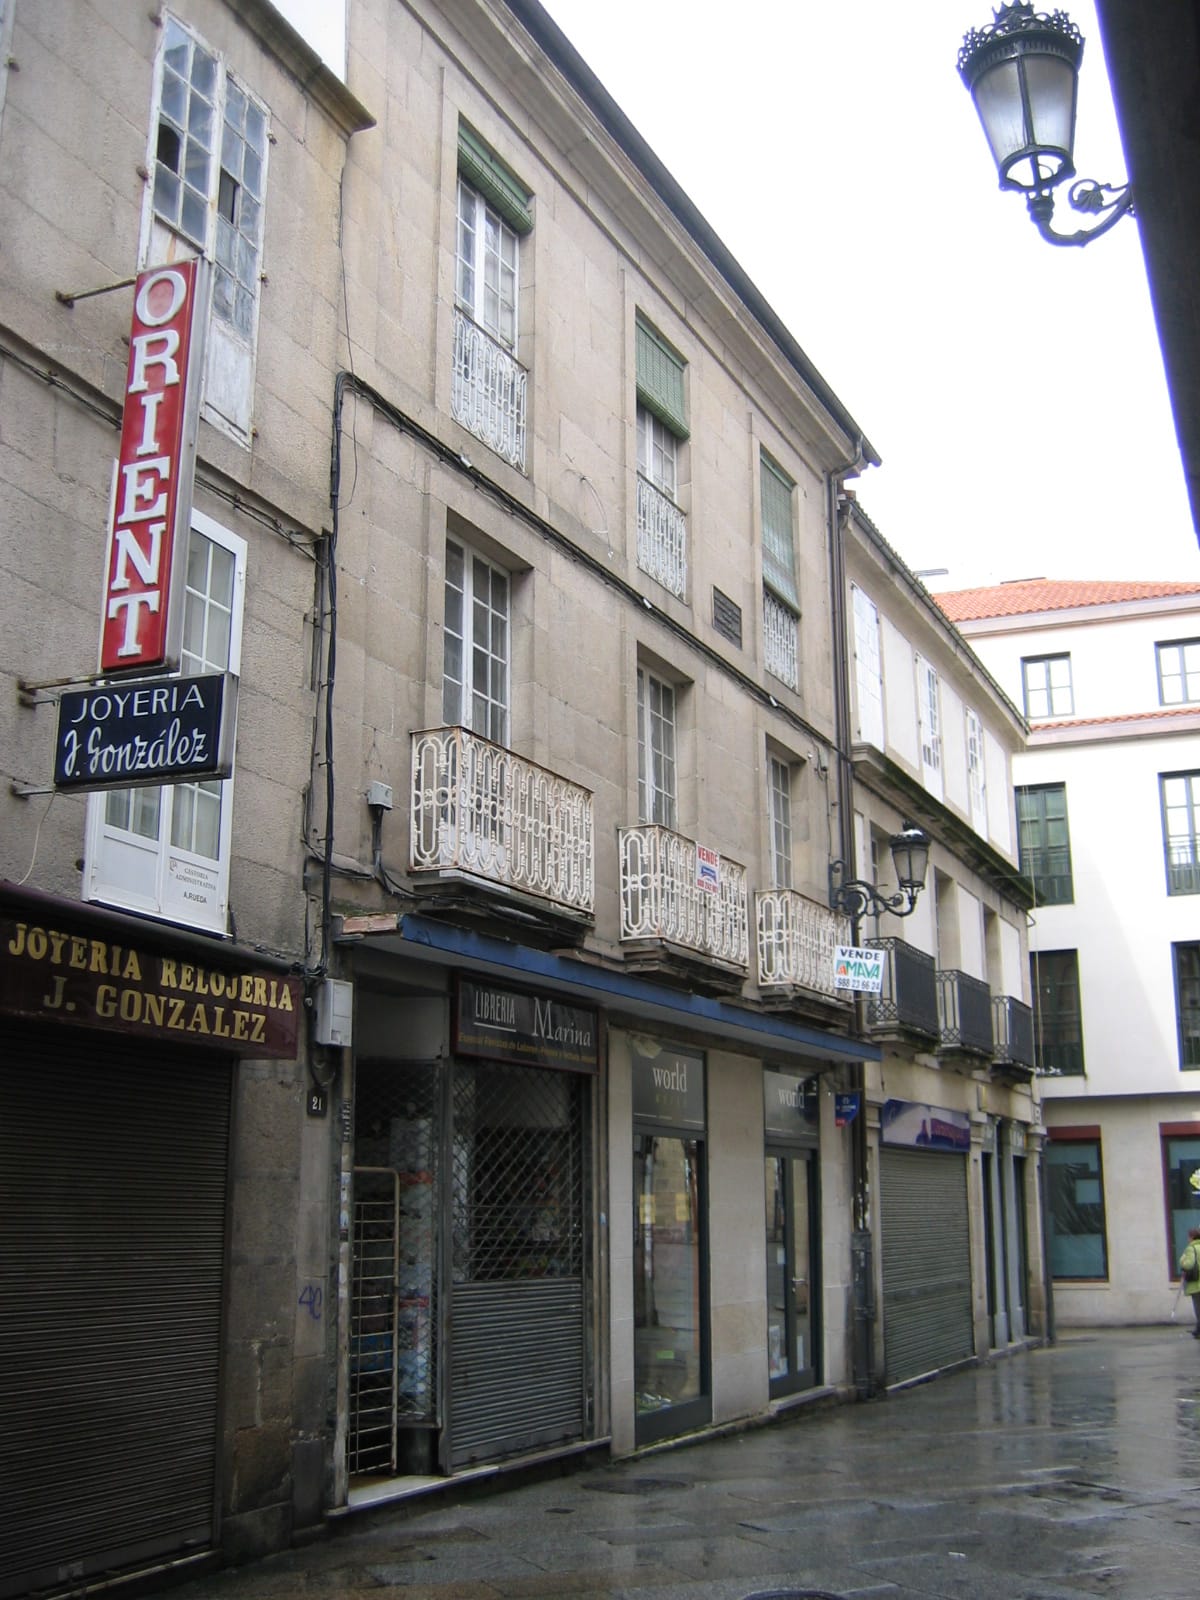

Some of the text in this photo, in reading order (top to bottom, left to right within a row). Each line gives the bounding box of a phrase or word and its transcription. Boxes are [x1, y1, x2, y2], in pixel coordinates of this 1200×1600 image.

[108, 269, 188, 658] ORIENT
[71, 684, 205, 723] JOYERIA
[87, 717, 209, 774] González
[697, 846, 719, 867] VENDE
[8, 923, 293, 1012] JOYERIA RELOJERIA
[840, 949, 881, 961] VENDE
[43, 976, 267, 1043] J. GONZALEZ
[475, 991, 516, 1025] LIBRERIA
[531, 996, 591, 1048] Marina
[652, 1061, 688, 1092] world
[312, 1095, 322, 1111] 21
